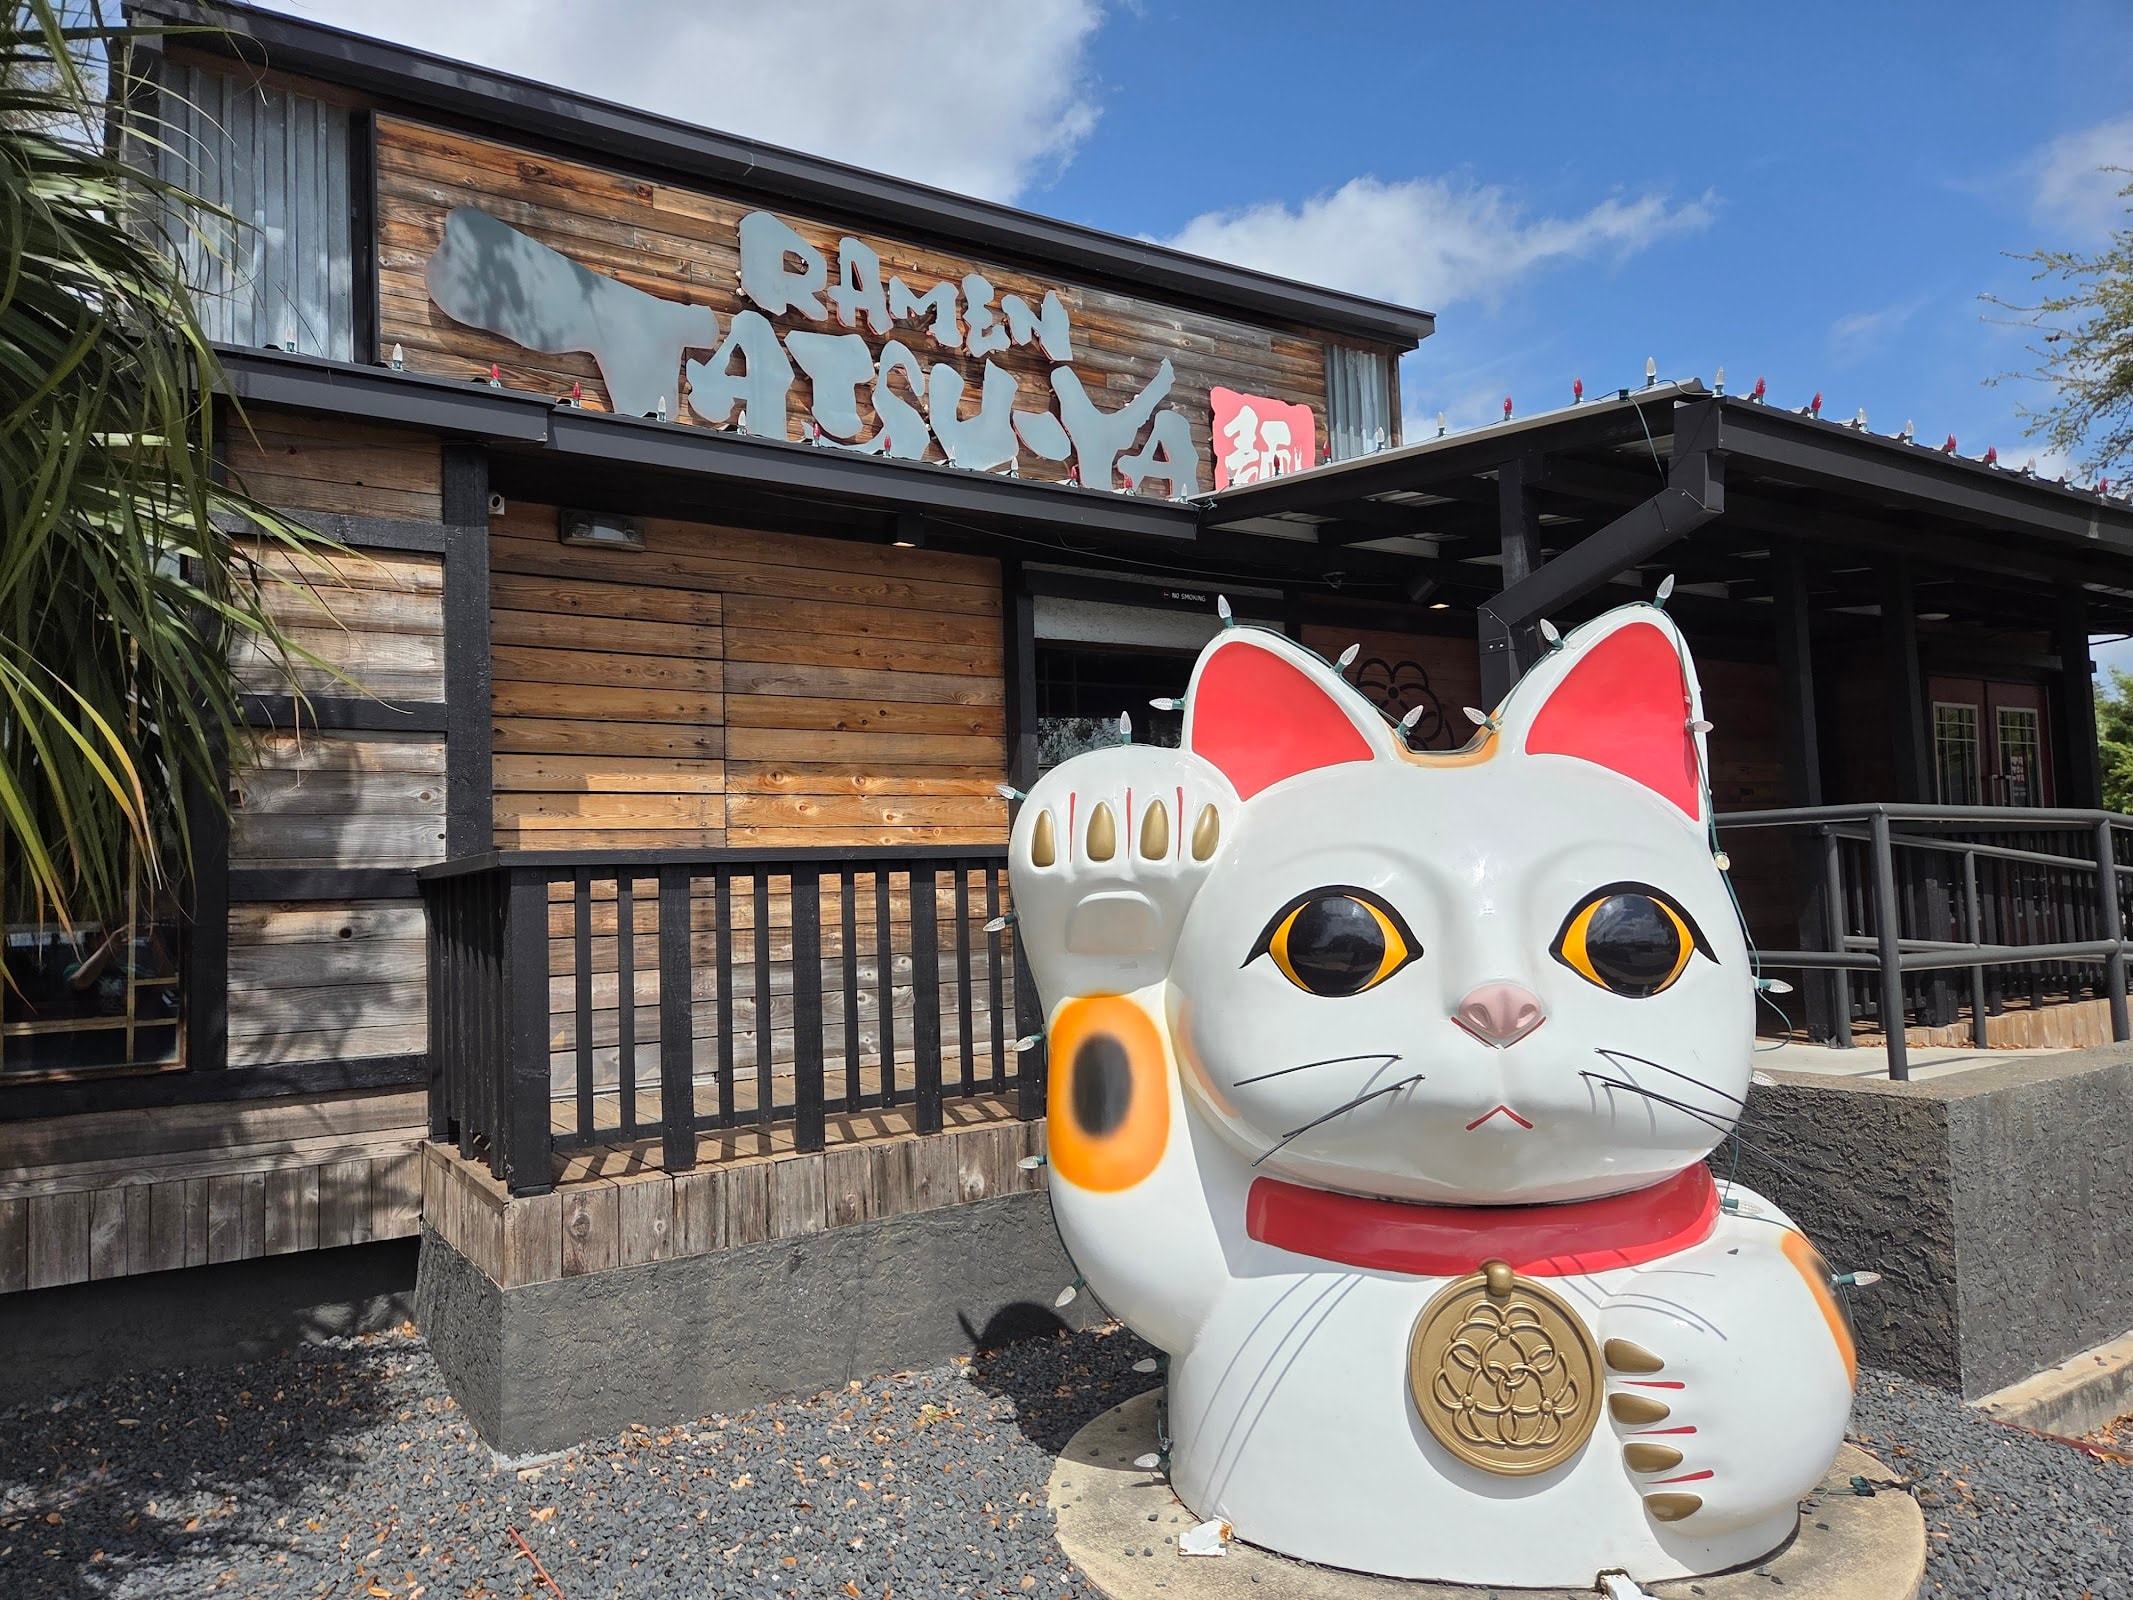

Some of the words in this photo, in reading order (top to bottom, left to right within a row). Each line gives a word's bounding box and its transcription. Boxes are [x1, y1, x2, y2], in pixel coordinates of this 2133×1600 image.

[424, 207, 1200, 497] TATSU-YA
[739, 210, 1074, 362] RAMEN
[1181, 593, 1206, 602] SMOKING
